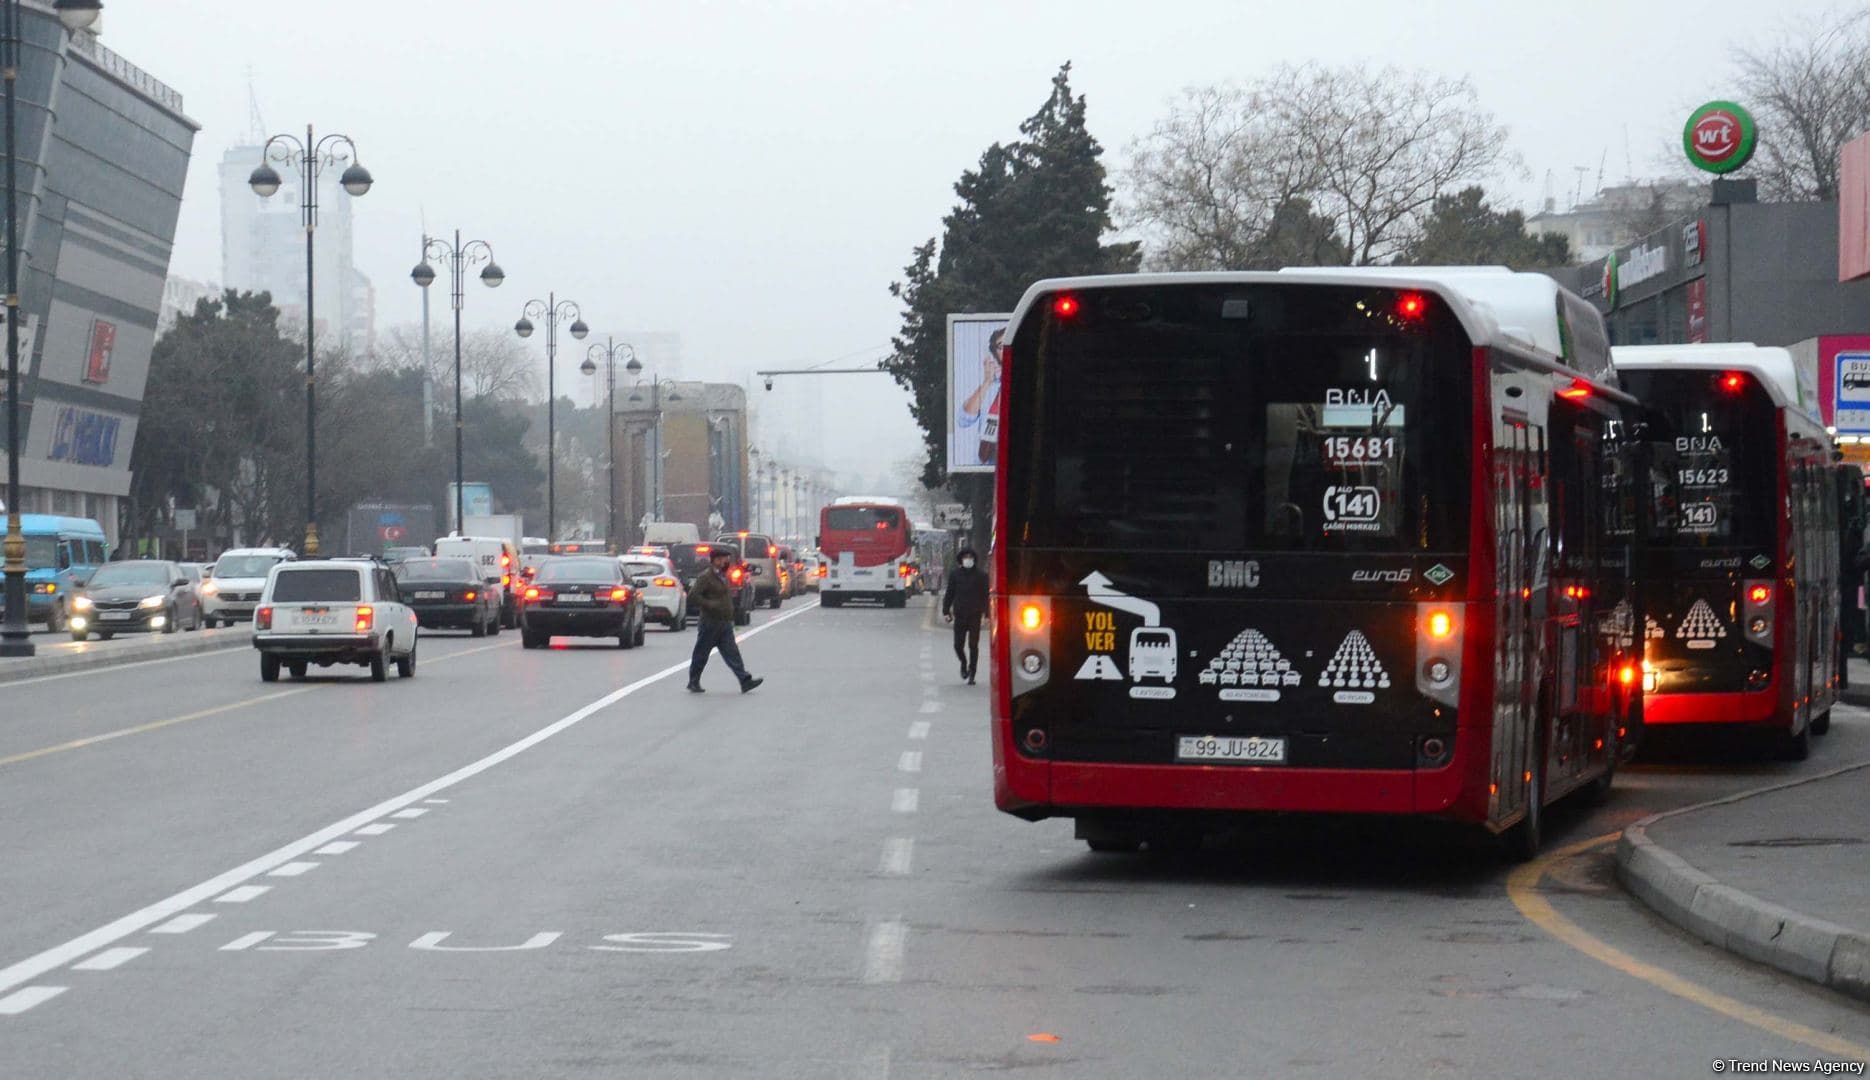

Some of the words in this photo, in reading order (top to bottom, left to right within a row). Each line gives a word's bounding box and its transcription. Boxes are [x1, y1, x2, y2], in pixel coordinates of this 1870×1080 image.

[1698, 125, 1731, 144] wt
[1851, 361, 1870, 371] BU
[1326, 388, 1391, 409] BNA
[1325, 437, 1394, 459] 15681
[1676, 436, 1722, 451] BNA
[1679, 469, 1728, 484] 15623
[1335, 494, 1374, 516] 141
[1686, 508, 1712, 522] 141
[1208, 560, 1260, 588] BMC
[1352, 568, 1411, 582] euro6
[1085, 612, 1116, 631] YOL
[1085, 632, 1115, 651] VER
[217, 930, 733, 953] BUS
